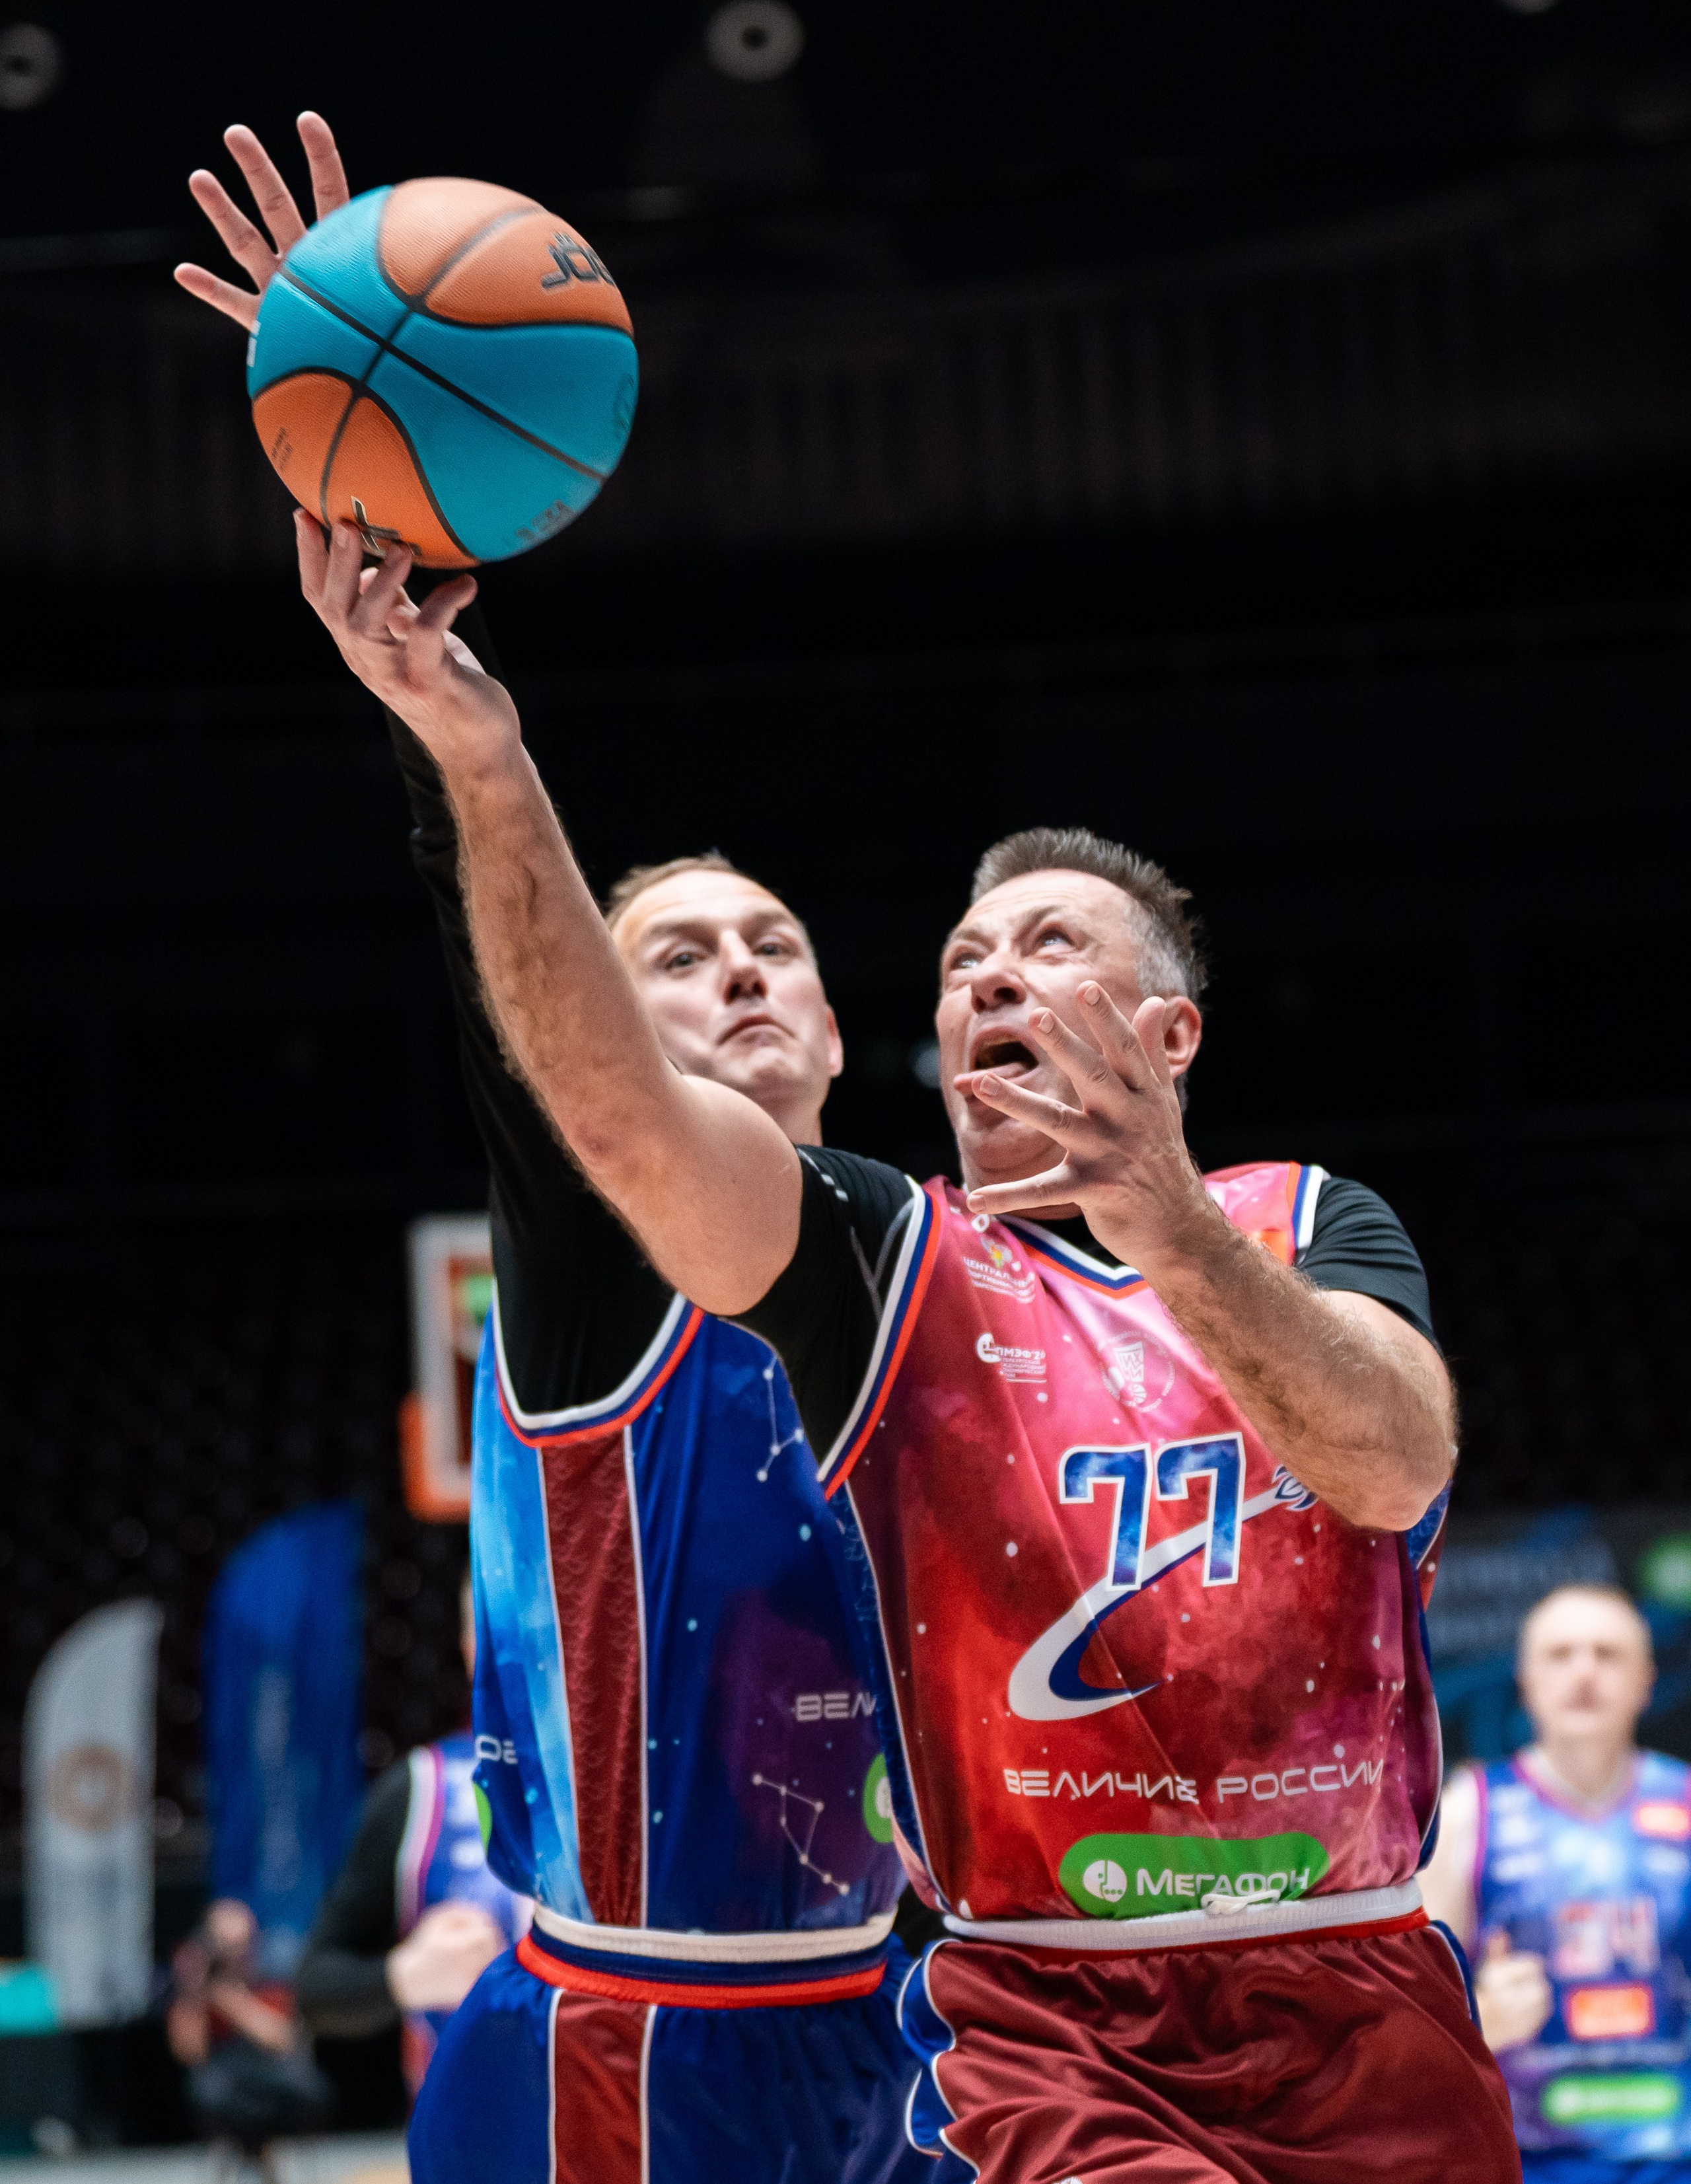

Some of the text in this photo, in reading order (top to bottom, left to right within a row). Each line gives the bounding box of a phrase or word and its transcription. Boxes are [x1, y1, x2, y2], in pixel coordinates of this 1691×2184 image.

[1058, 1431, 1246, 1591] 77
[1003, 1758, 1384, 1805] ВЕЛИЧИЕ РОССИИ
